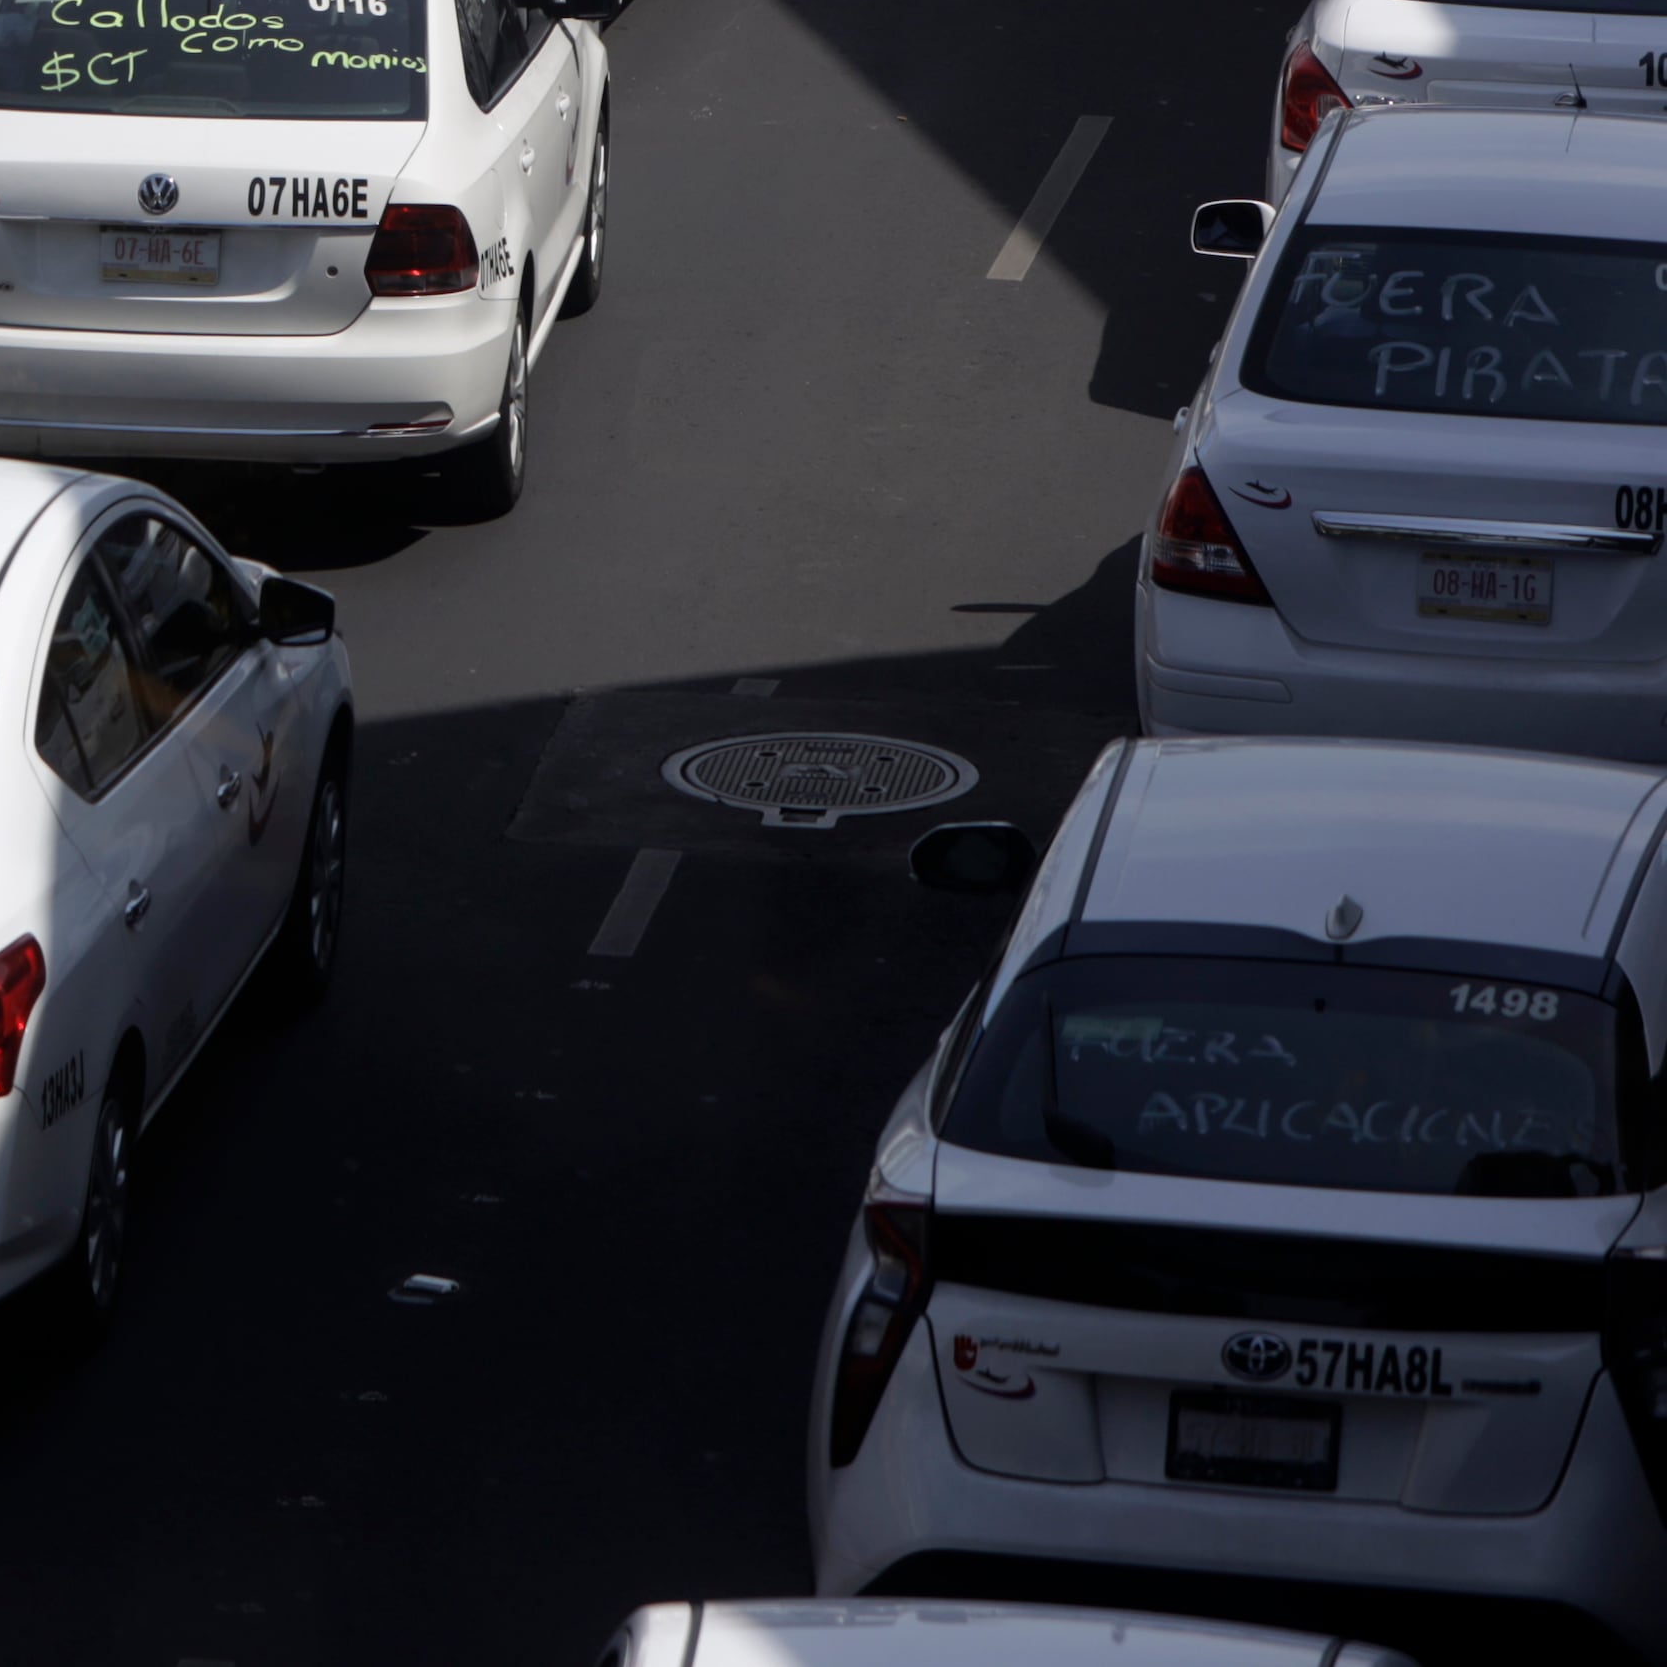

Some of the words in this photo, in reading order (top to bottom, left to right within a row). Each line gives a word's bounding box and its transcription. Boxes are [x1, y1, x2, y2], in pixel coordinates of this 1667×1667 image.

[247, 177, 368, 218] 07HA6E
[113, 238, 206, 267] 07-HA-6E
[1433, 569, 1536, 602] 08-HA-1G
[1449, 983, 1560, 1022] 1498
[1295, 1338, 1452, 1398] 57HA8L
